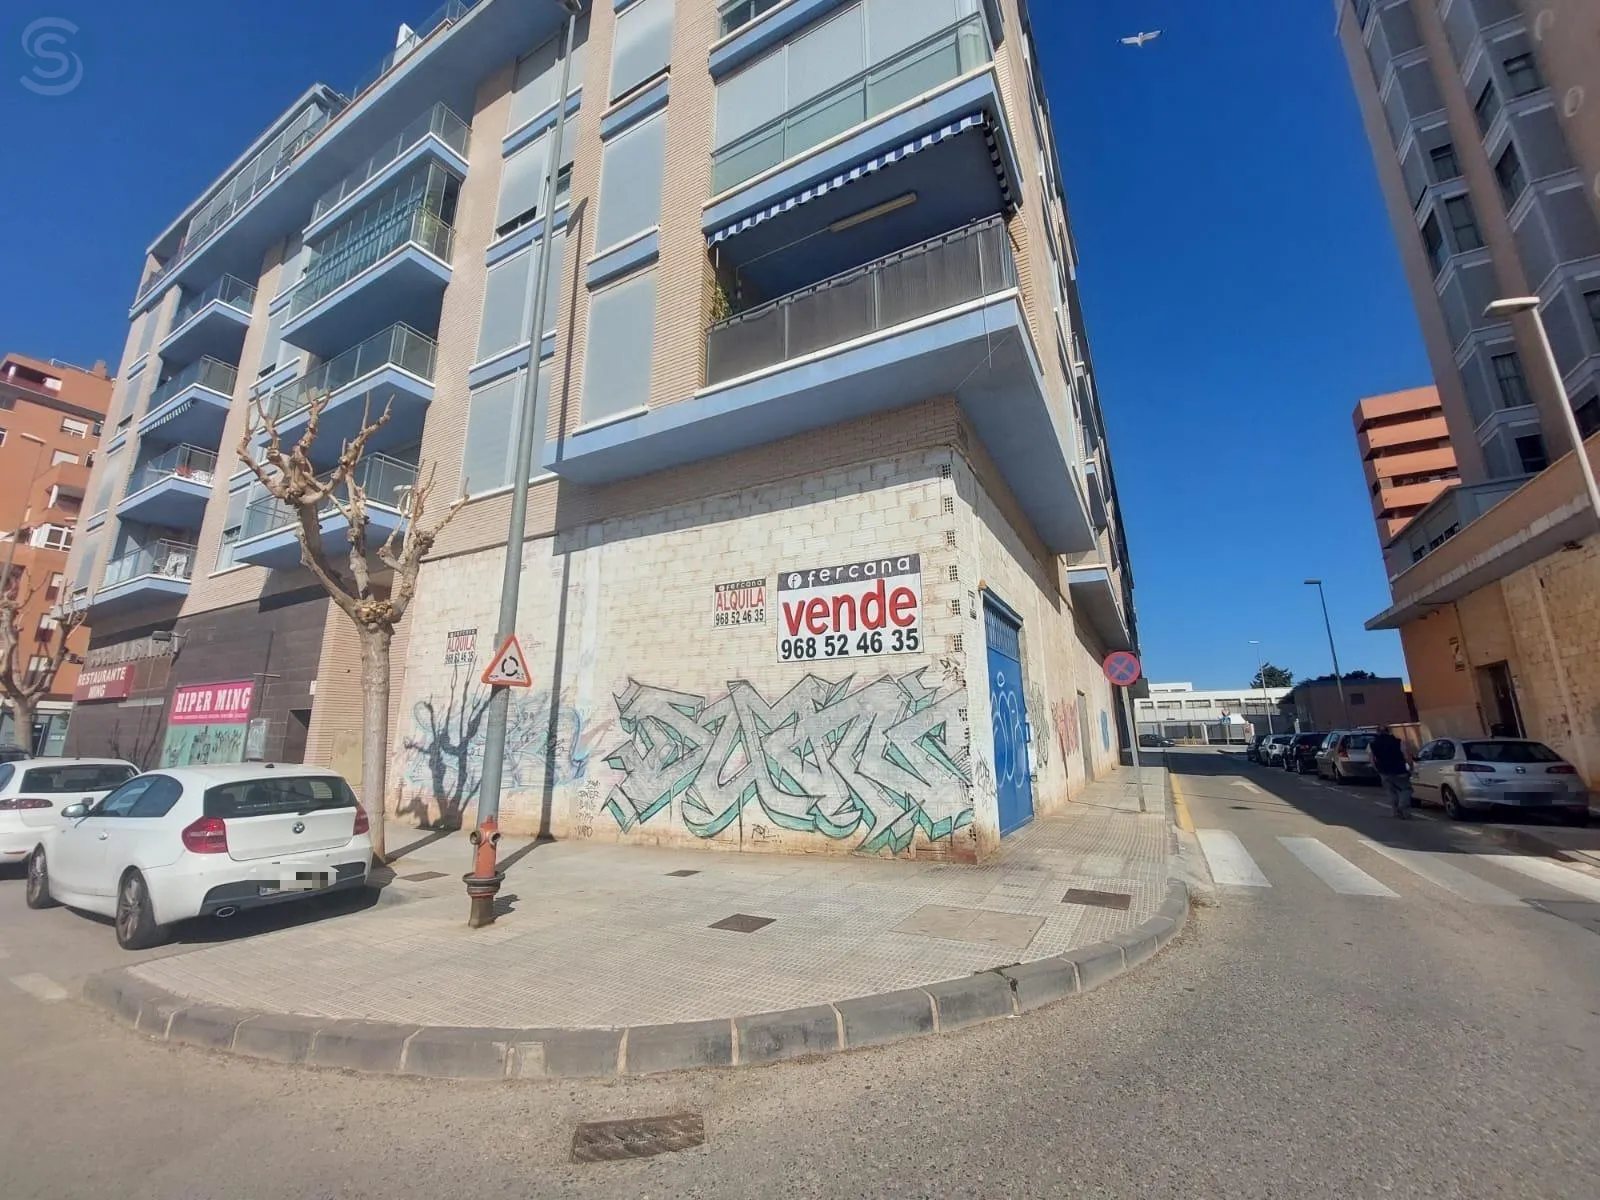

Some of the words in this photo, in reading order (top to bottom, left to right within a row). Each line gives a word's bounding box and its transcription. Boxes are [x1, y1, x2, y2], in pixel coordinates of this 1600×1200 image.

[808, 557, 910, 588] fercana
[716, 587, 764, 611] ALQUILA
[782, 578, 917, 636] vende
[716, 612, 728, 625] 968
[731, 611, 740, 623] 52
[743, 610, 751, 622] 46
[755, 609, 763, 621] 35
[447, 635, 475, 652] ALQUILA
[781, 637, 817, 660] 968
[824, 635, 849, 656] 52
[856, 631, 883, 653] 46
[891, 628, 919, 651] 35
[77, 666, 127, 687] RESTAURANTE
[175, 691, 212, 712] HIPER
[214, 687, 251, 711] MING
